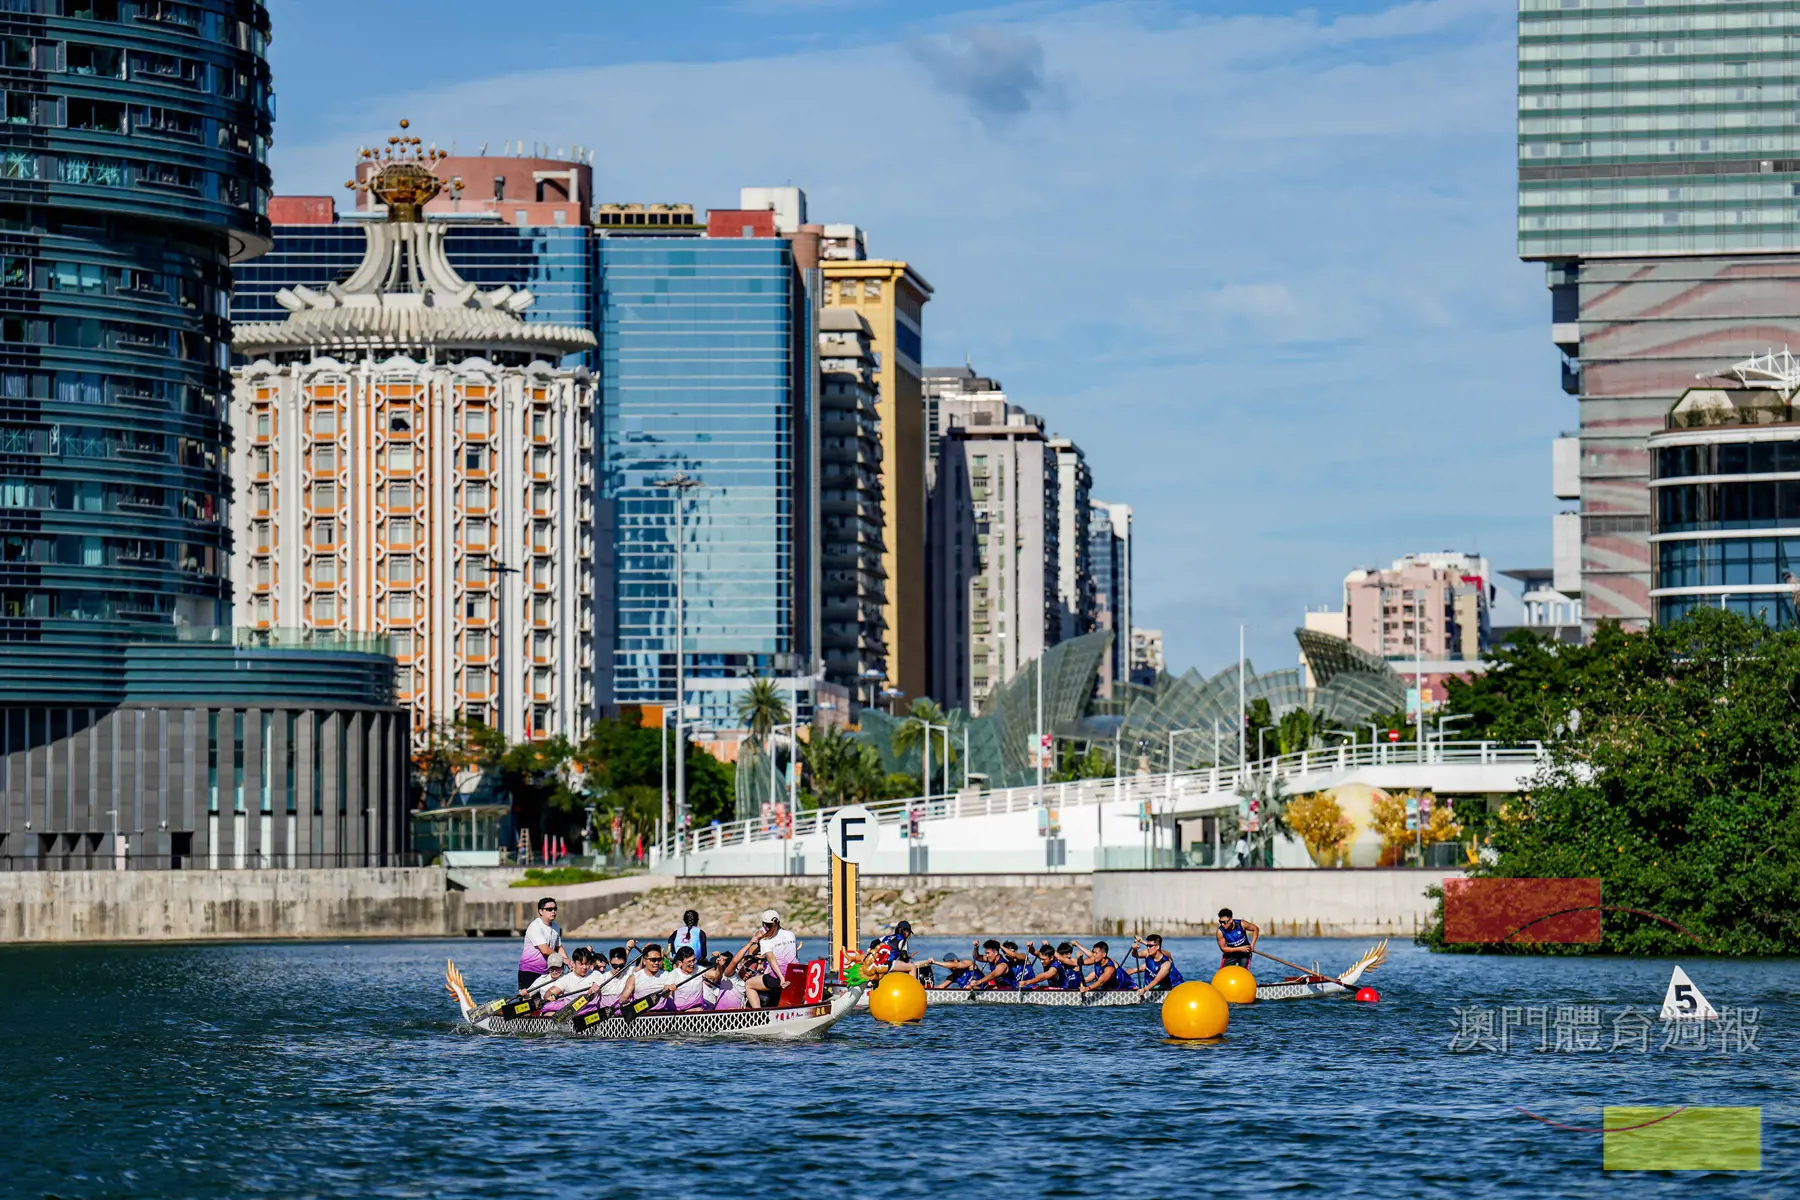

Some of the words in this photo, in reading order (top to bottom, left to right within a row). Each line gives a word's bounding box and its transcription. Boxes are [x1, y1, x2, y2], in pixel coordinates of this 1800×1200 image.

[841, 817, 866, 858] F
[808, 962, 822, 999] 3
[1674, 984, 1698, 1015] 5
